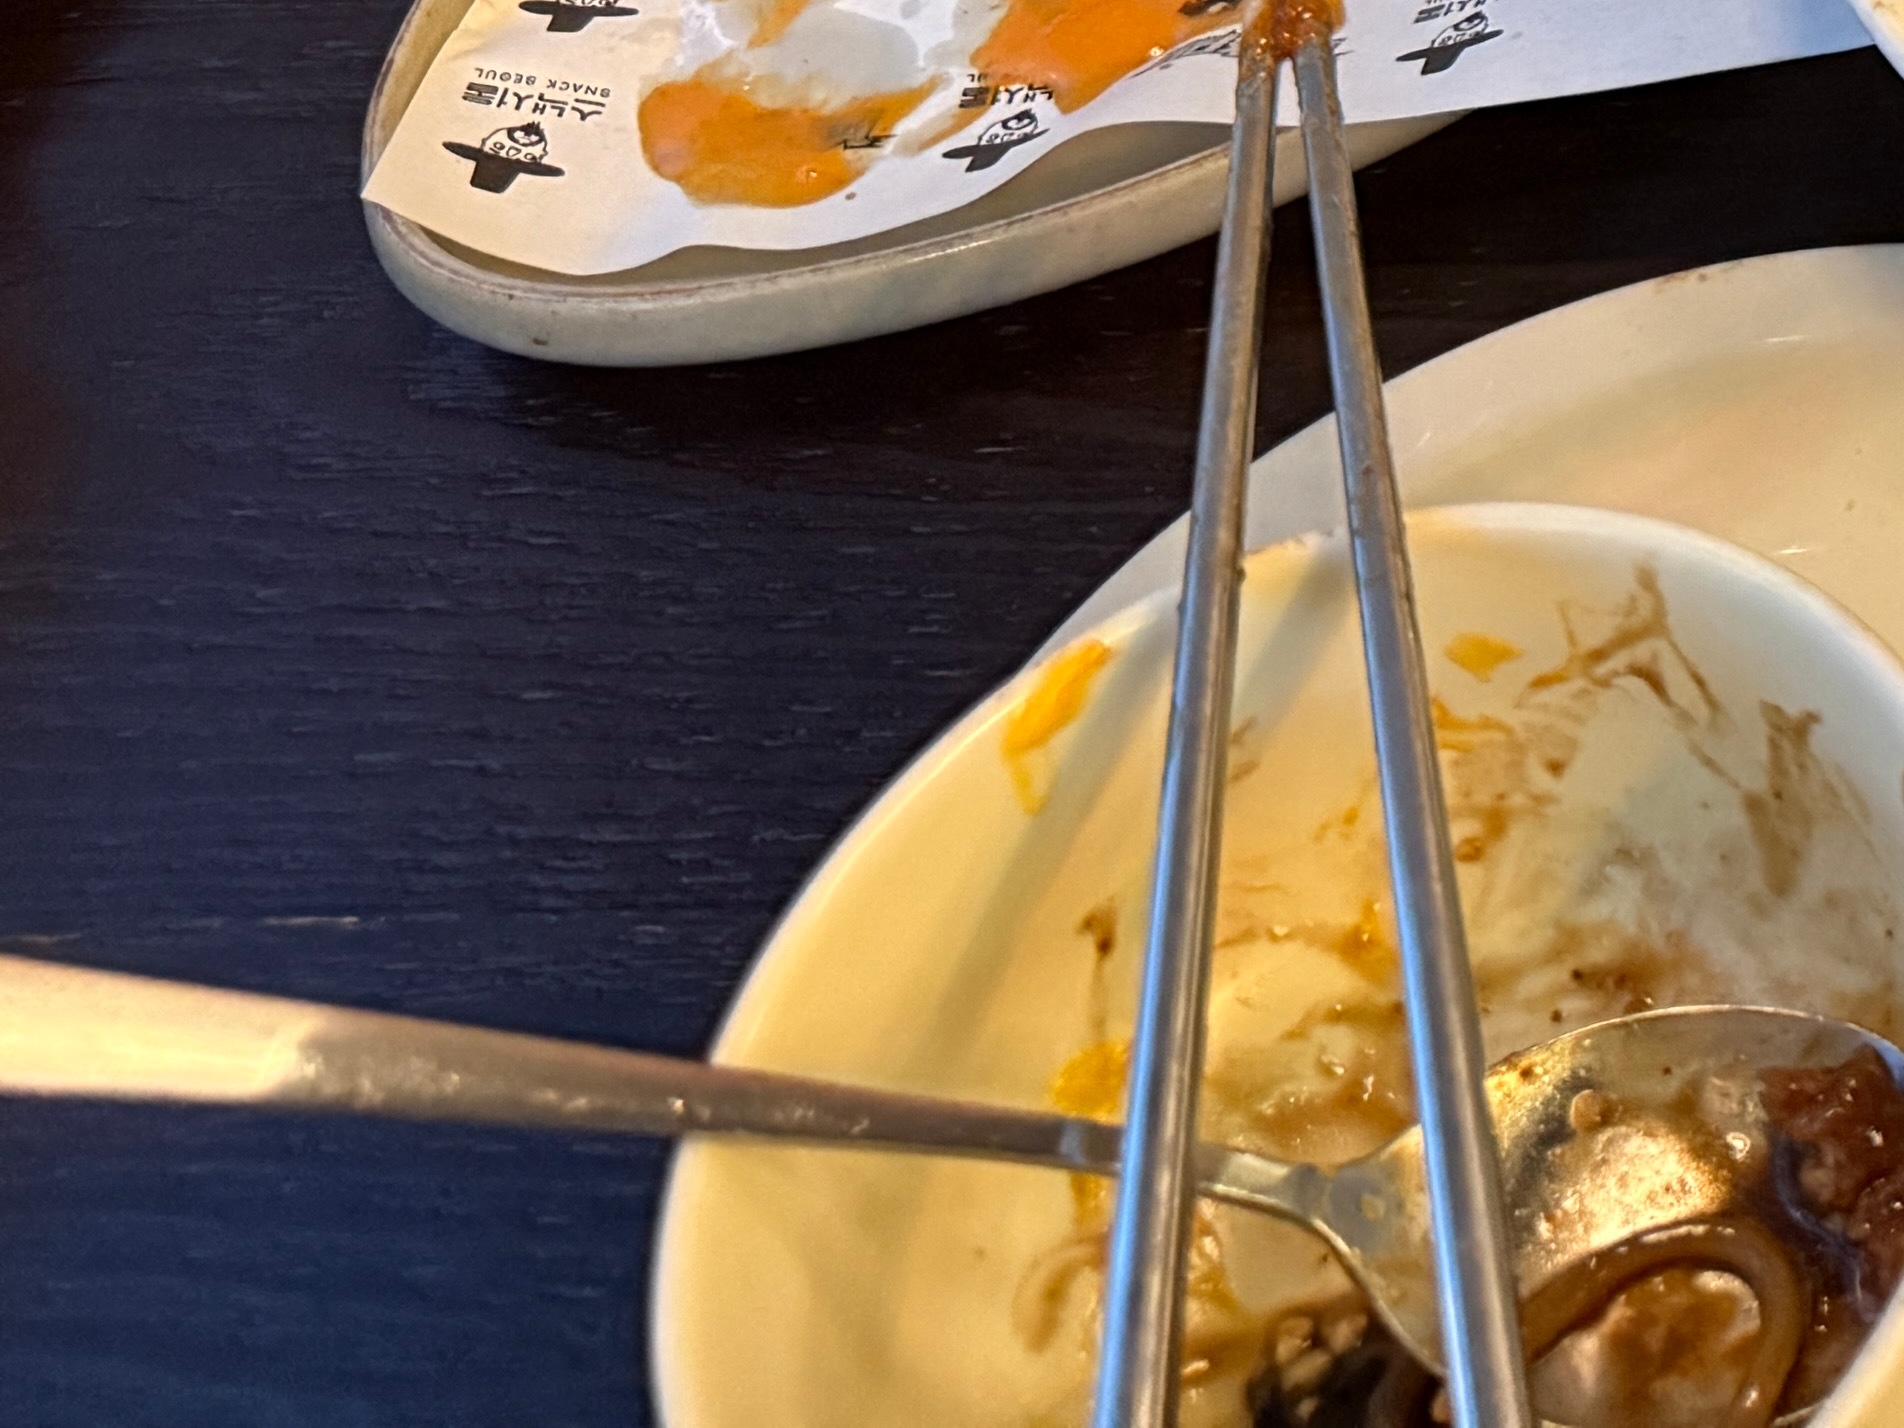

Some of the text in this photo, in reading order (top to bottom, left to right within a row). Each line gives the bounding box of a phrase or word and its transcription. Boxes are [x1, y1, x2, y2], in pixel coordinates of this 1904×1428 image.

[474, 67, 611, 98] SNACK SEOUL
[462, 82, 606, 121] 스낵서울
